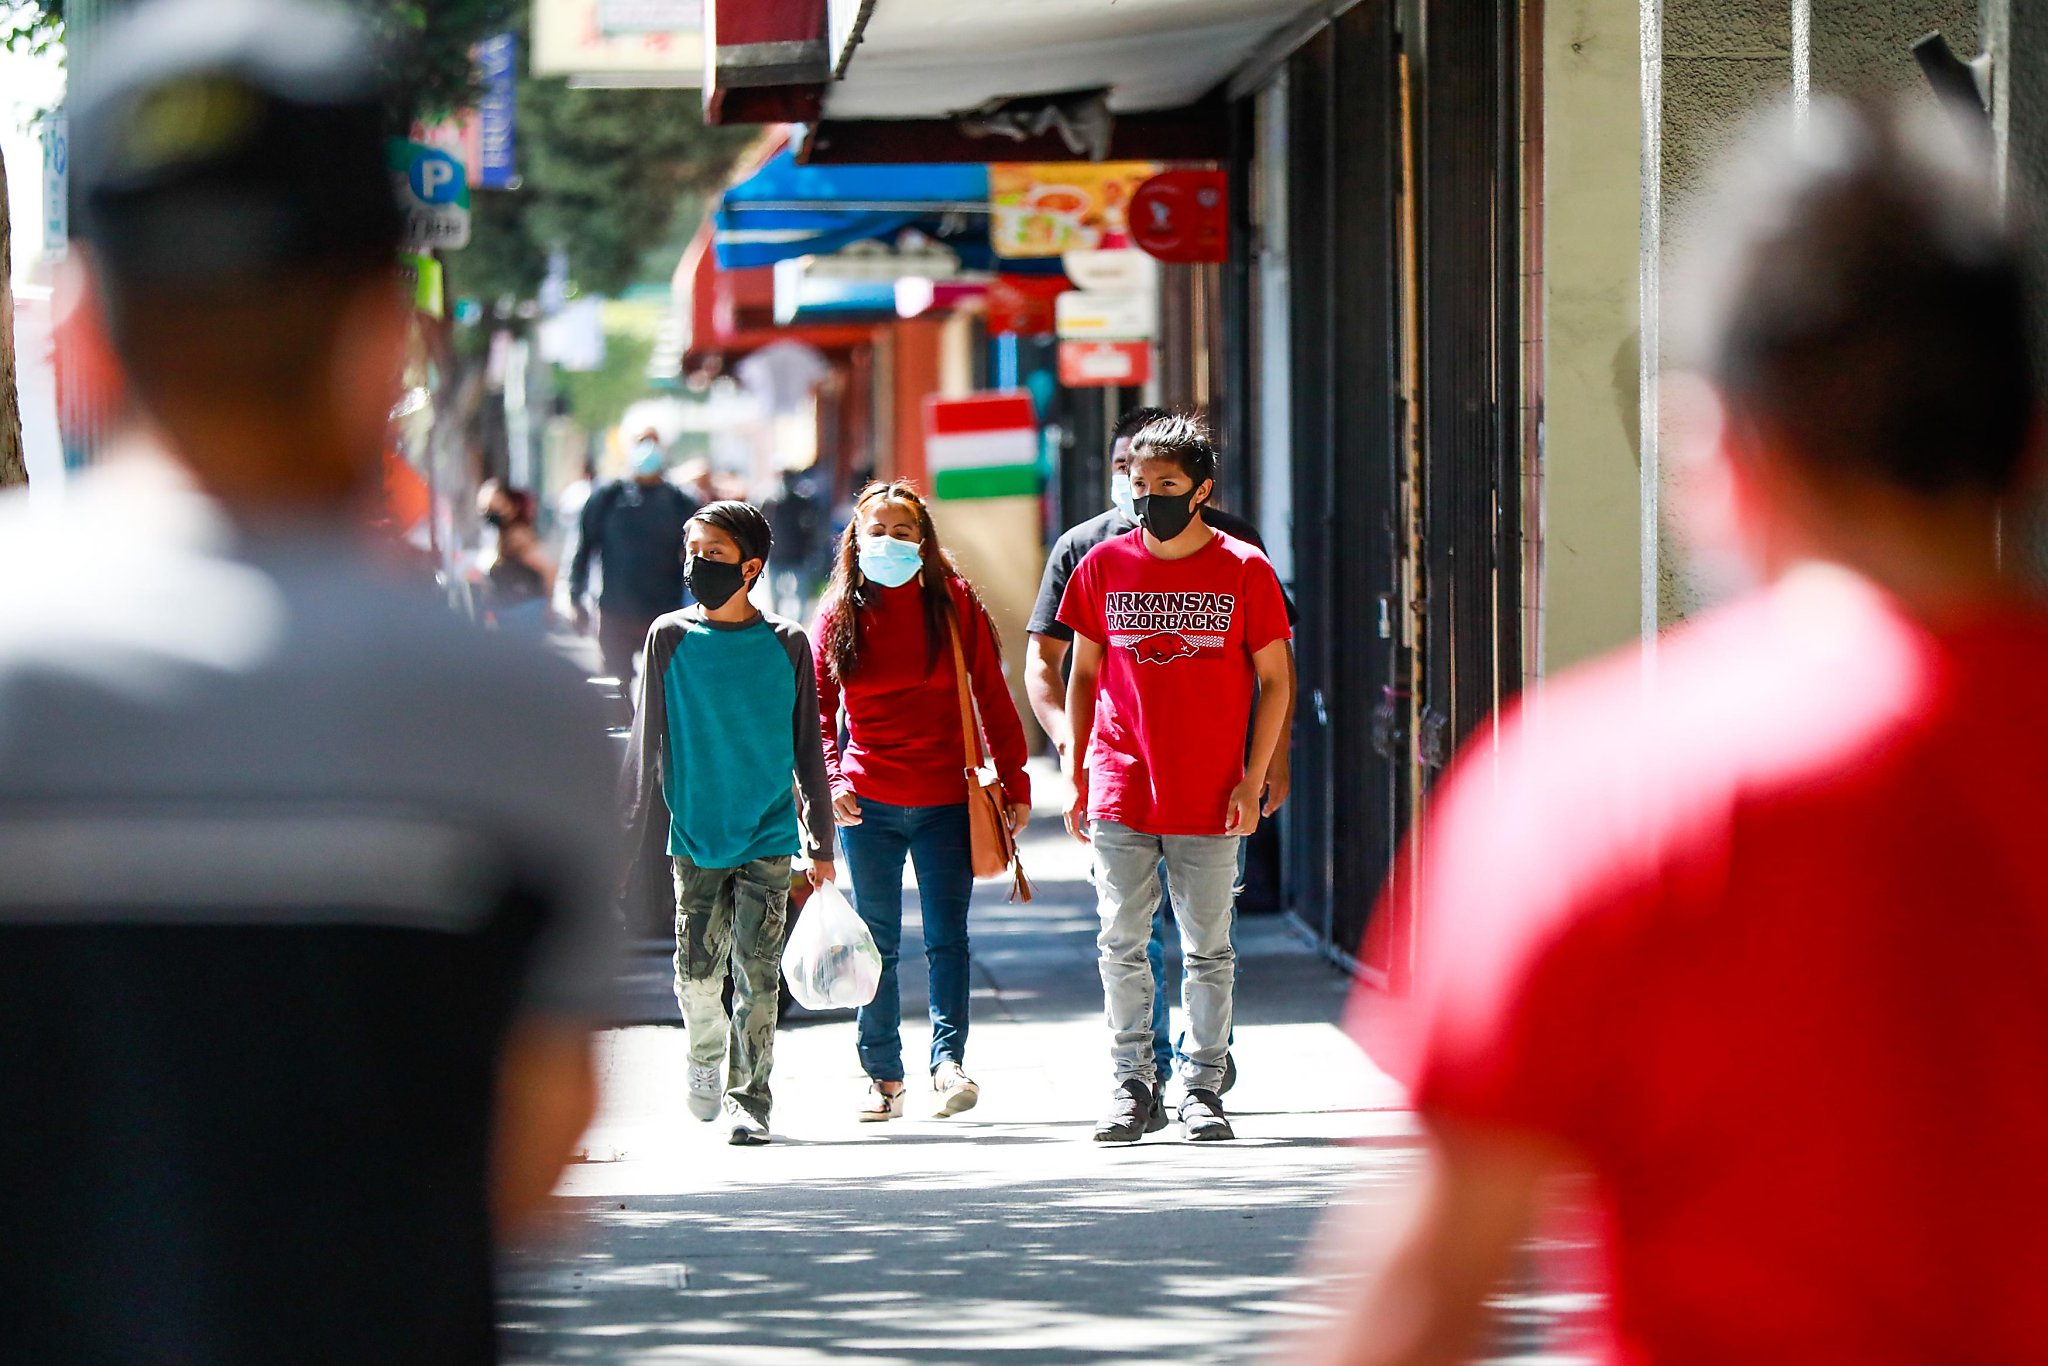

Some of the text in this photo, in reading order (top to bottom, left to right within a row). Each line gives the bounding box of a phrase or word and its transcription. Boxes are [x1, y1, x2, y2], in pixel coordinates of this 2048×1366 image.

[422, 160, 453, 198] P
[1106, 592, 1235, 613] ARKANSAS
[1108, 612, 1231, 631] RAZORBACKS
